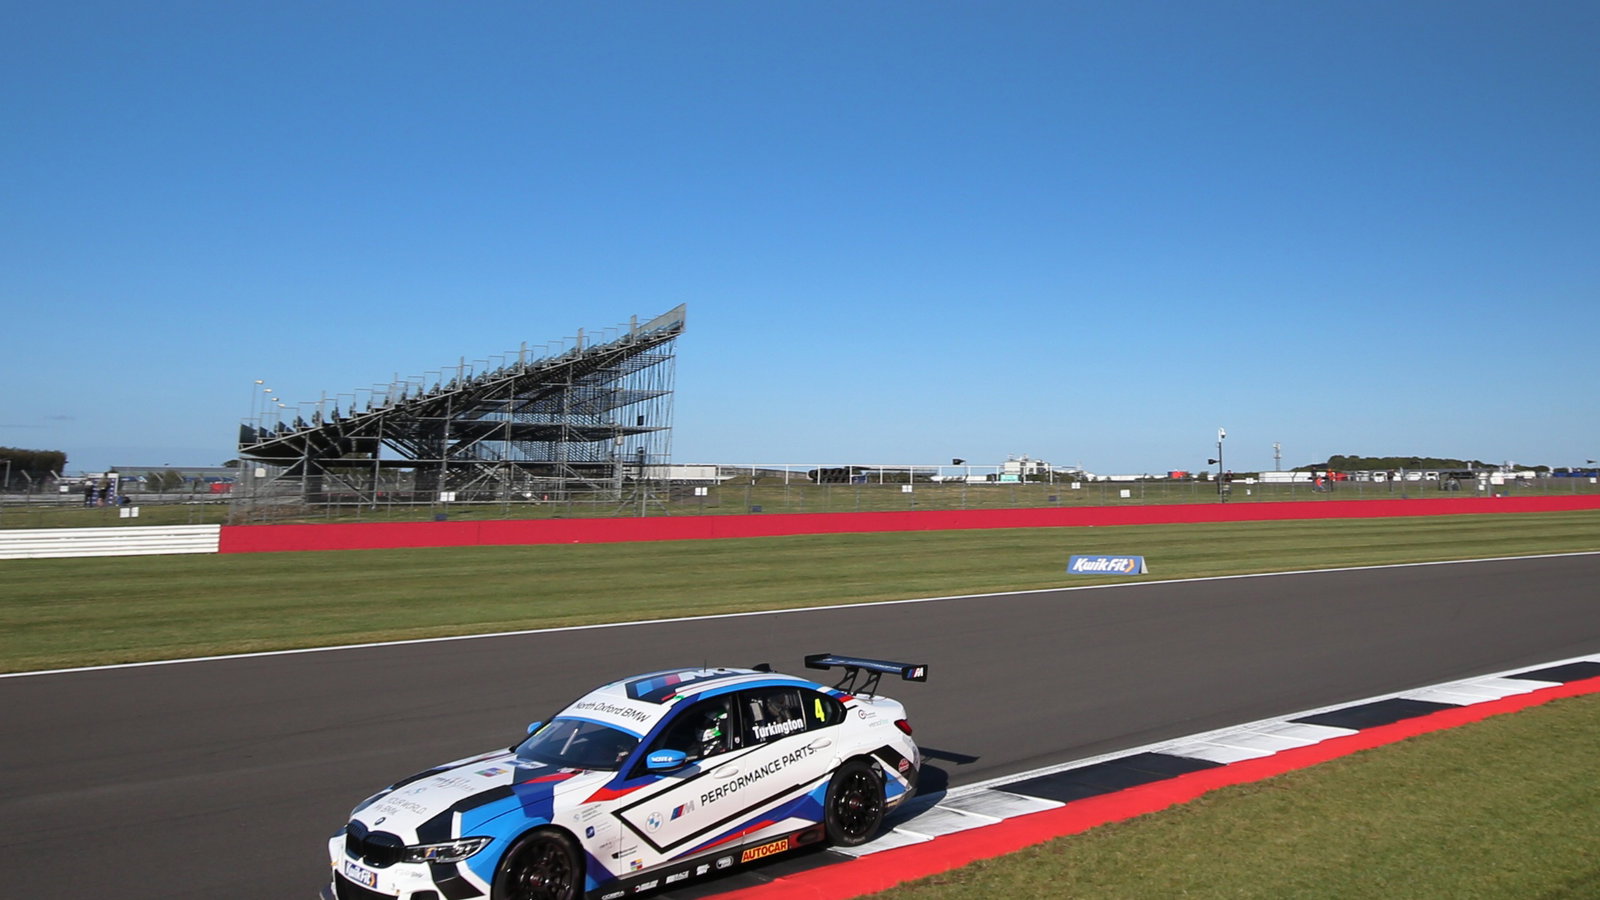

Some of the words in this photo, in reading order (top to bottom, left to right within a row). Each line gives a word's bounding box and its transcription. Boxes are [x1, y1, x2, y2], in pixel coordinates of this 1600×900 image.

[574, 702, 596, 710] North
[594, 702, 624, 715] Oxford
[621, 707, 652, 722] BMW
[814, 698, 826, 722] 4
[752, 718, 804, 739] Turkington
[700, 759, 782, 807] PERFORMANCE
[743, 841, 787, 860] AUTOCAR
